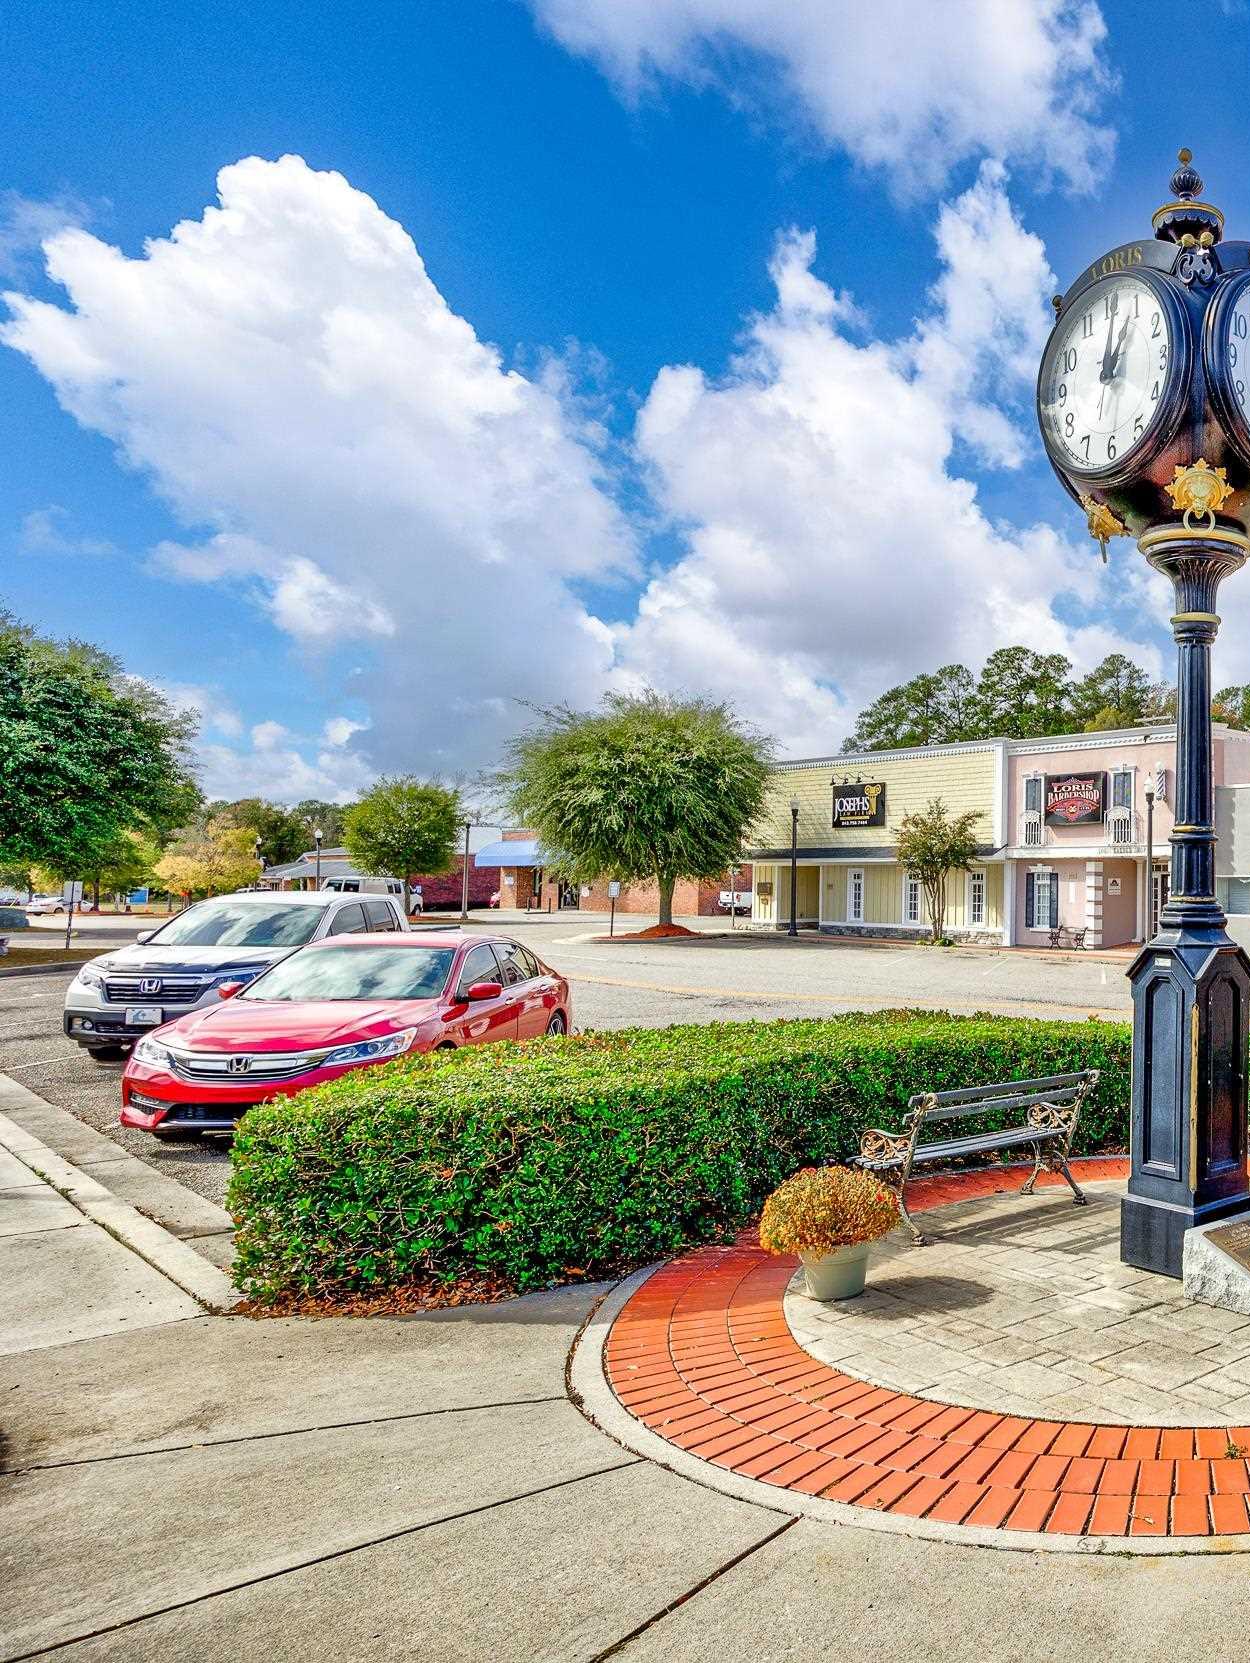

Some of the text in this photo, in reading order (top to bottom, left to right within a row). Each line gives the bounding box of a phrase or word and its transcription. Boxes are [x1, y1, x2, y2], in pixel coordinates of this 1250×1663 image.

[1090, 247, 1144, 280] LORIS
[1133, 294, 1141, 319] 1
[1082, 313, 1094, 340] 11
[1152, 312, 1162, 339] 2
[1233, 311, 1247, 340] 10
[1063, 347, 1078, 375] 10
[1160, 345, 1168, 371] 3
[1228, 342, 1237, 368] 9
[1058, 384, 1067, 408] 9
[1151, 381, 1159, 402] 4
[1235, 380, 1245, 406] 8
[1064, 412, 1074, 438] 8
[1133, 414, 1144, 441] 5
[1080, 435, 1091, 460] 7
[1107, 435, 1117, 460] 6
[1047, 789, 1100, 807] BARBERSHOP
[1053, 784, 1093, 792] LORIS
[834, 797, 869, 821] JOSEPHS
